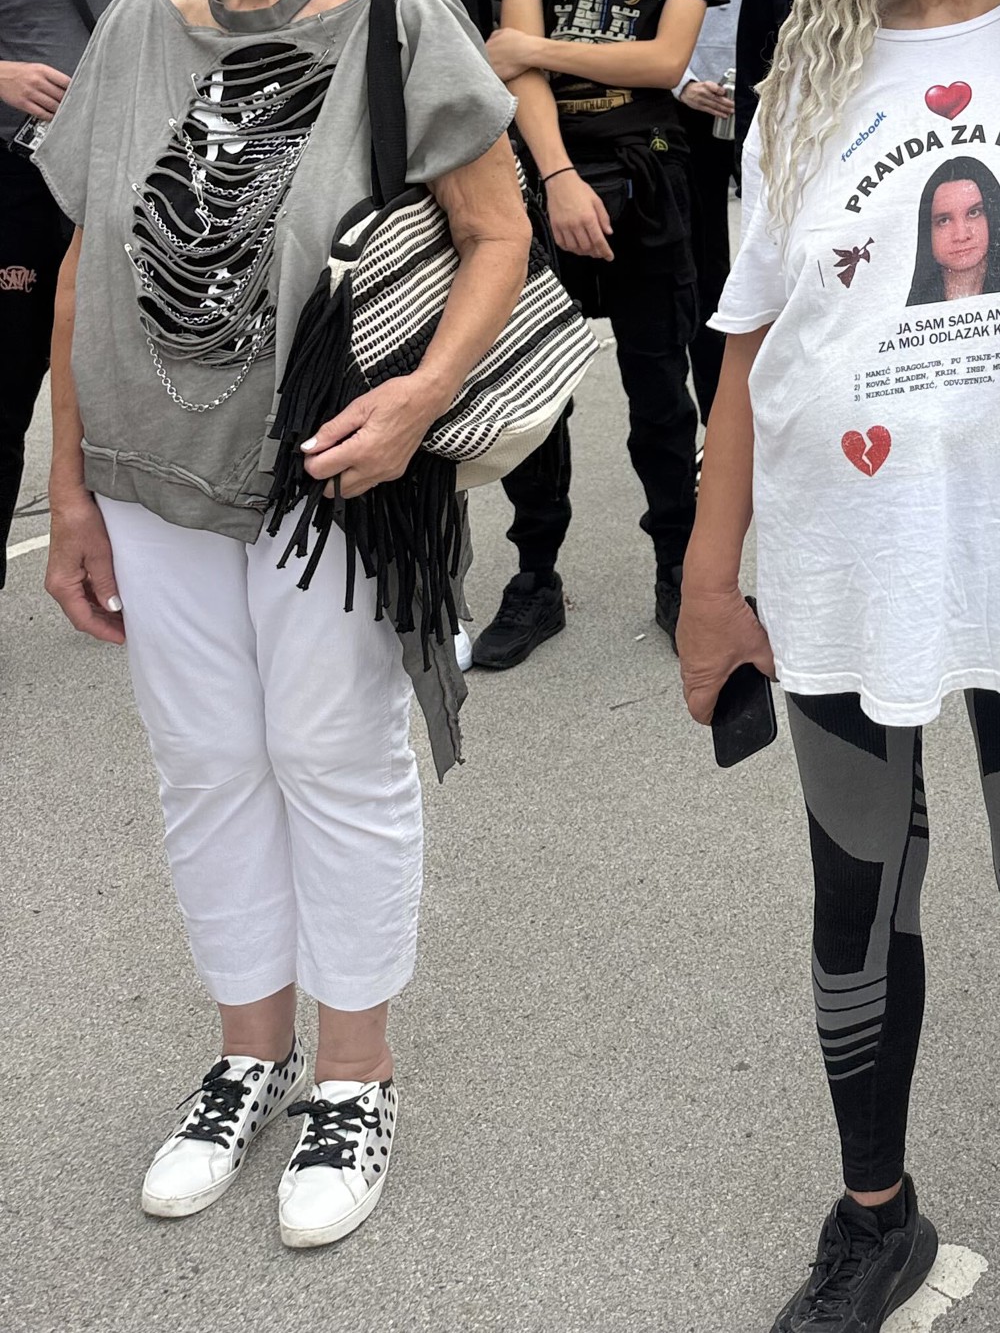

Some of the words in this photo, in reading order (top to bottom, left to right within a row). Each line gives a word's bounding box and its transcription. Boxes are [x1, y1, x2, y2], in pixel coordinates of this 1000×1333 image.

[840, 111, 888, 163] facebook
[844, 130, 944, 214] PRAVDA
[950, 124, 987, 146] ZA
[896, 322, 912, 336] JA
[915, 318, 945, 332] SAM
[948, 311, 983, 328] SADA
[878, 340, 896, 354] ZA
[898, 335, 926, 350] MOJ
[928, 324, 990, 345] ODLAZAK
[865, 387, 906, 399] NIKOLINA
